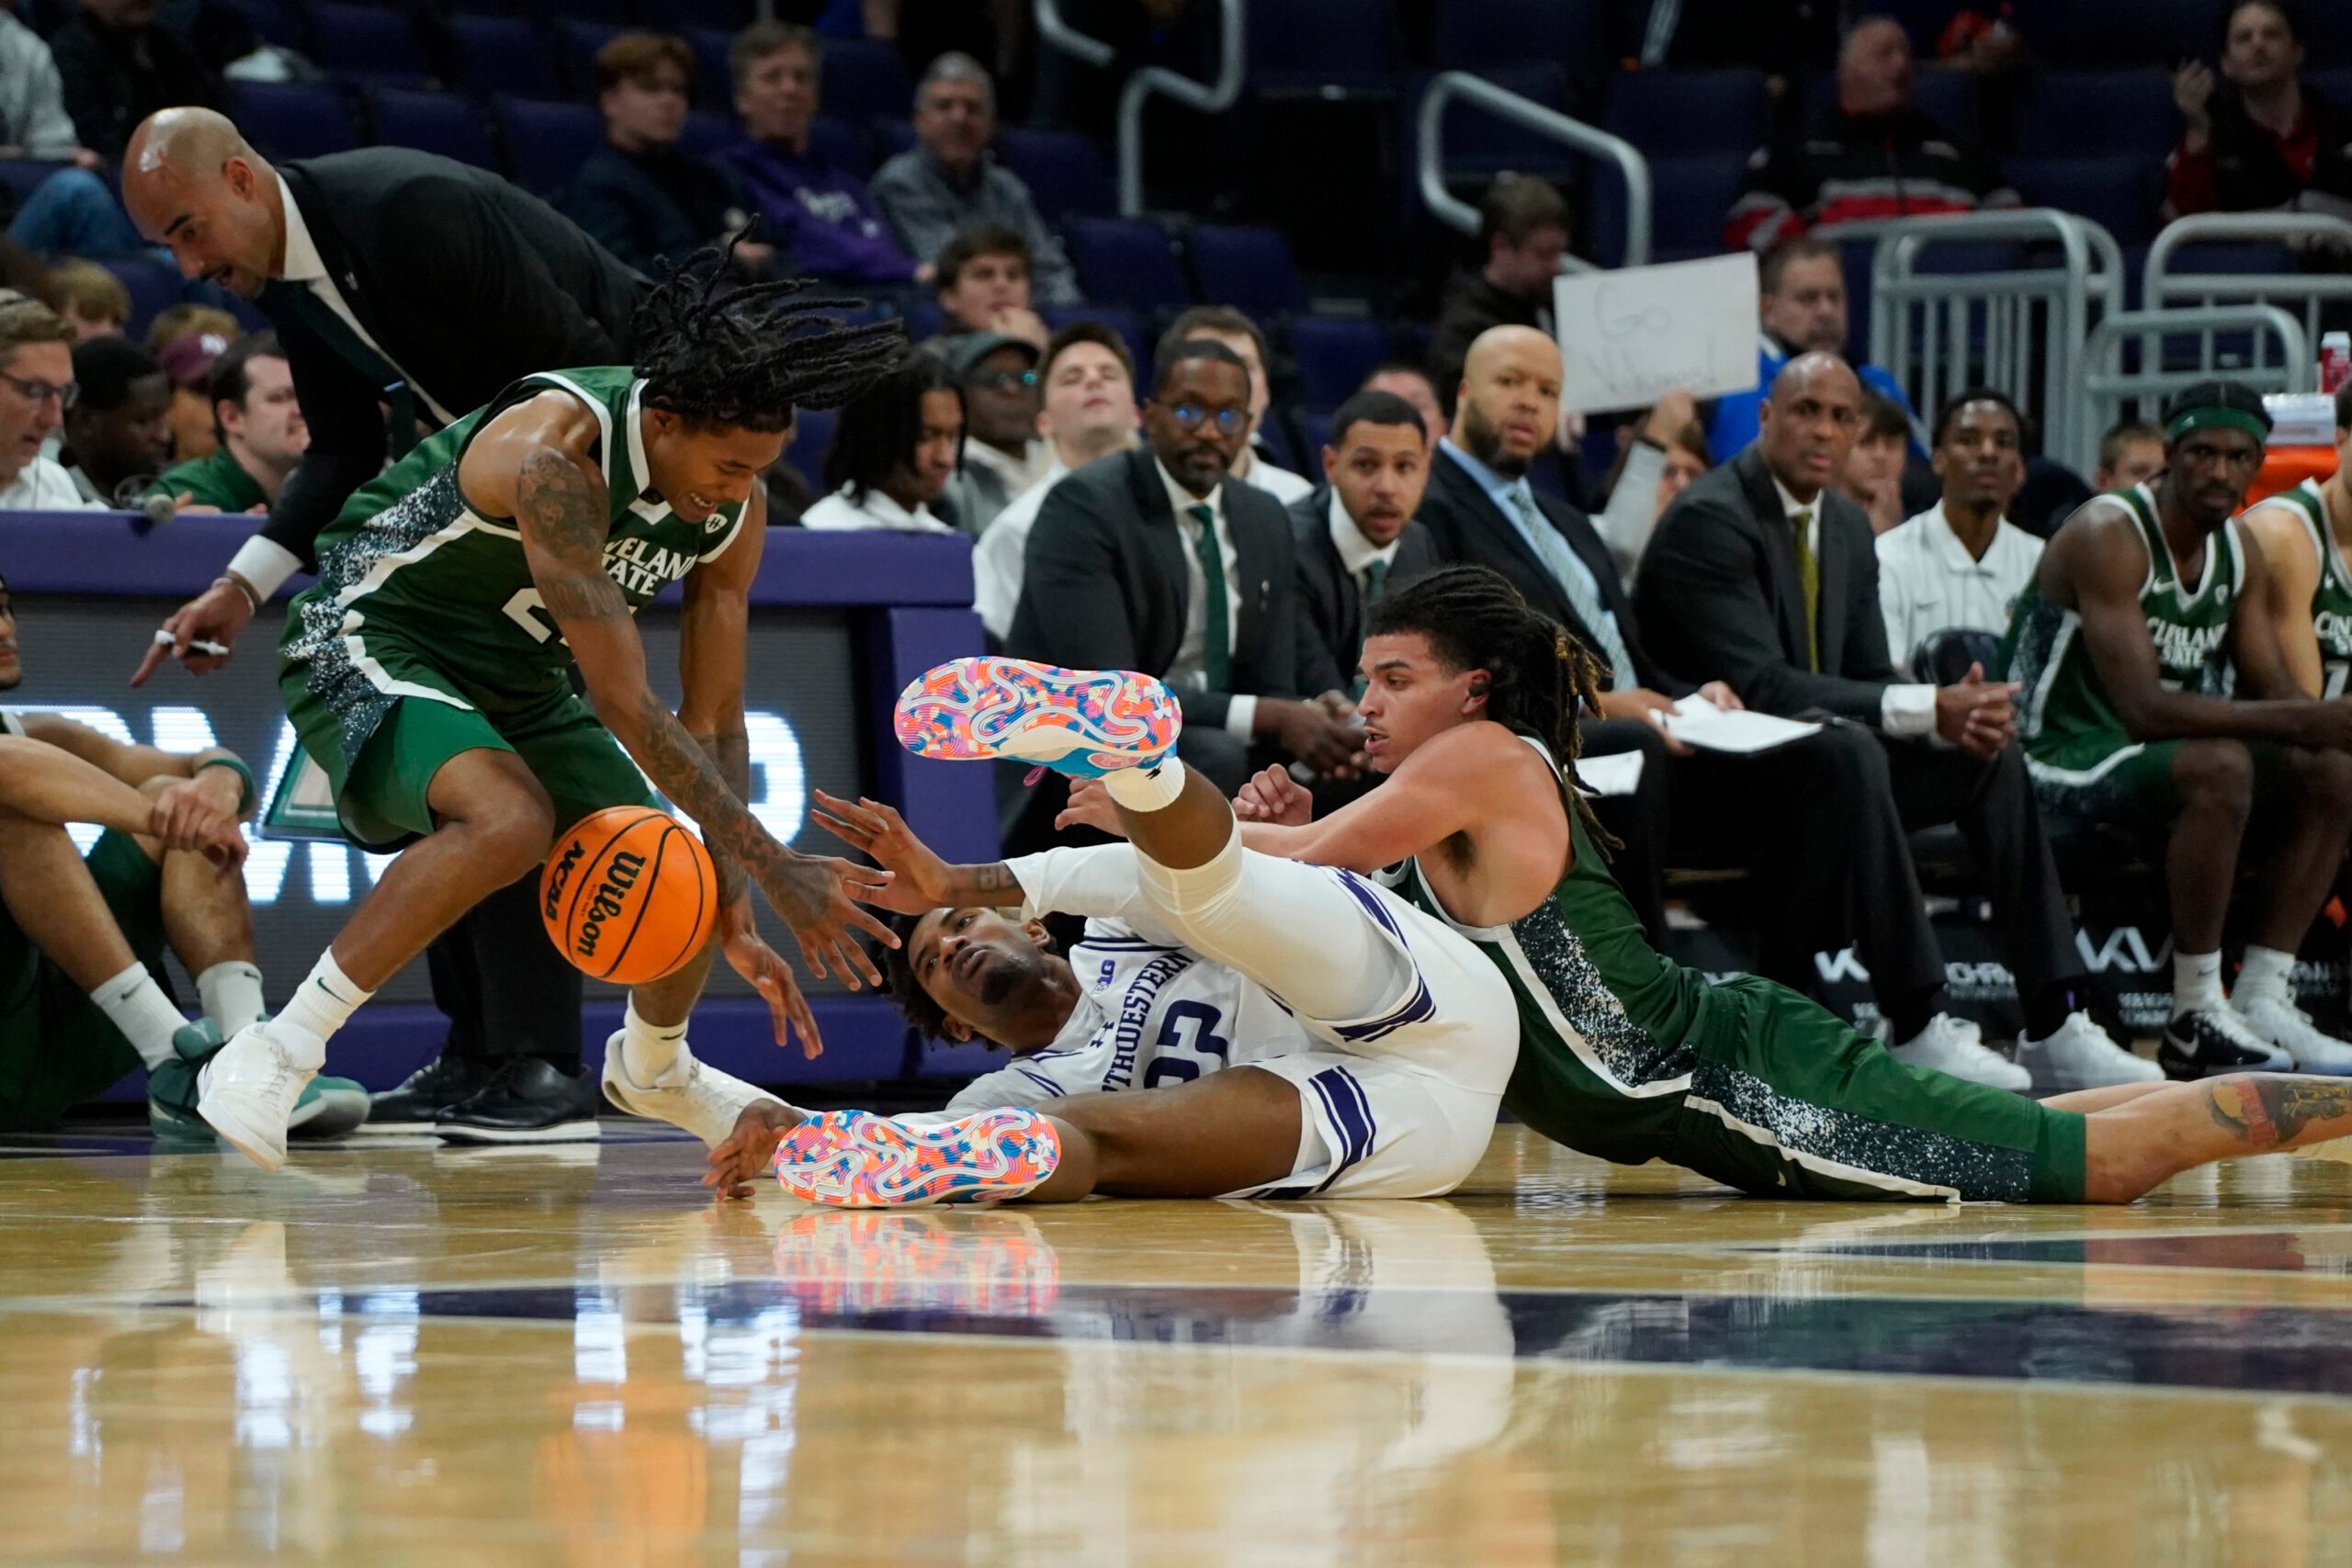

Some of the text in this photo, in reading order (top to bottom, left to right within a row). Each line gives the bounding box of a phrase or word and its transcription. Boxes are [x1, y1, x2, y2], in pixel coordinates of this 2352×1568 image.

[601, 553, 660, 596] TATE
[545, 840, 586, 921] NCAA
[577, 851, 647, 957] Wilson
